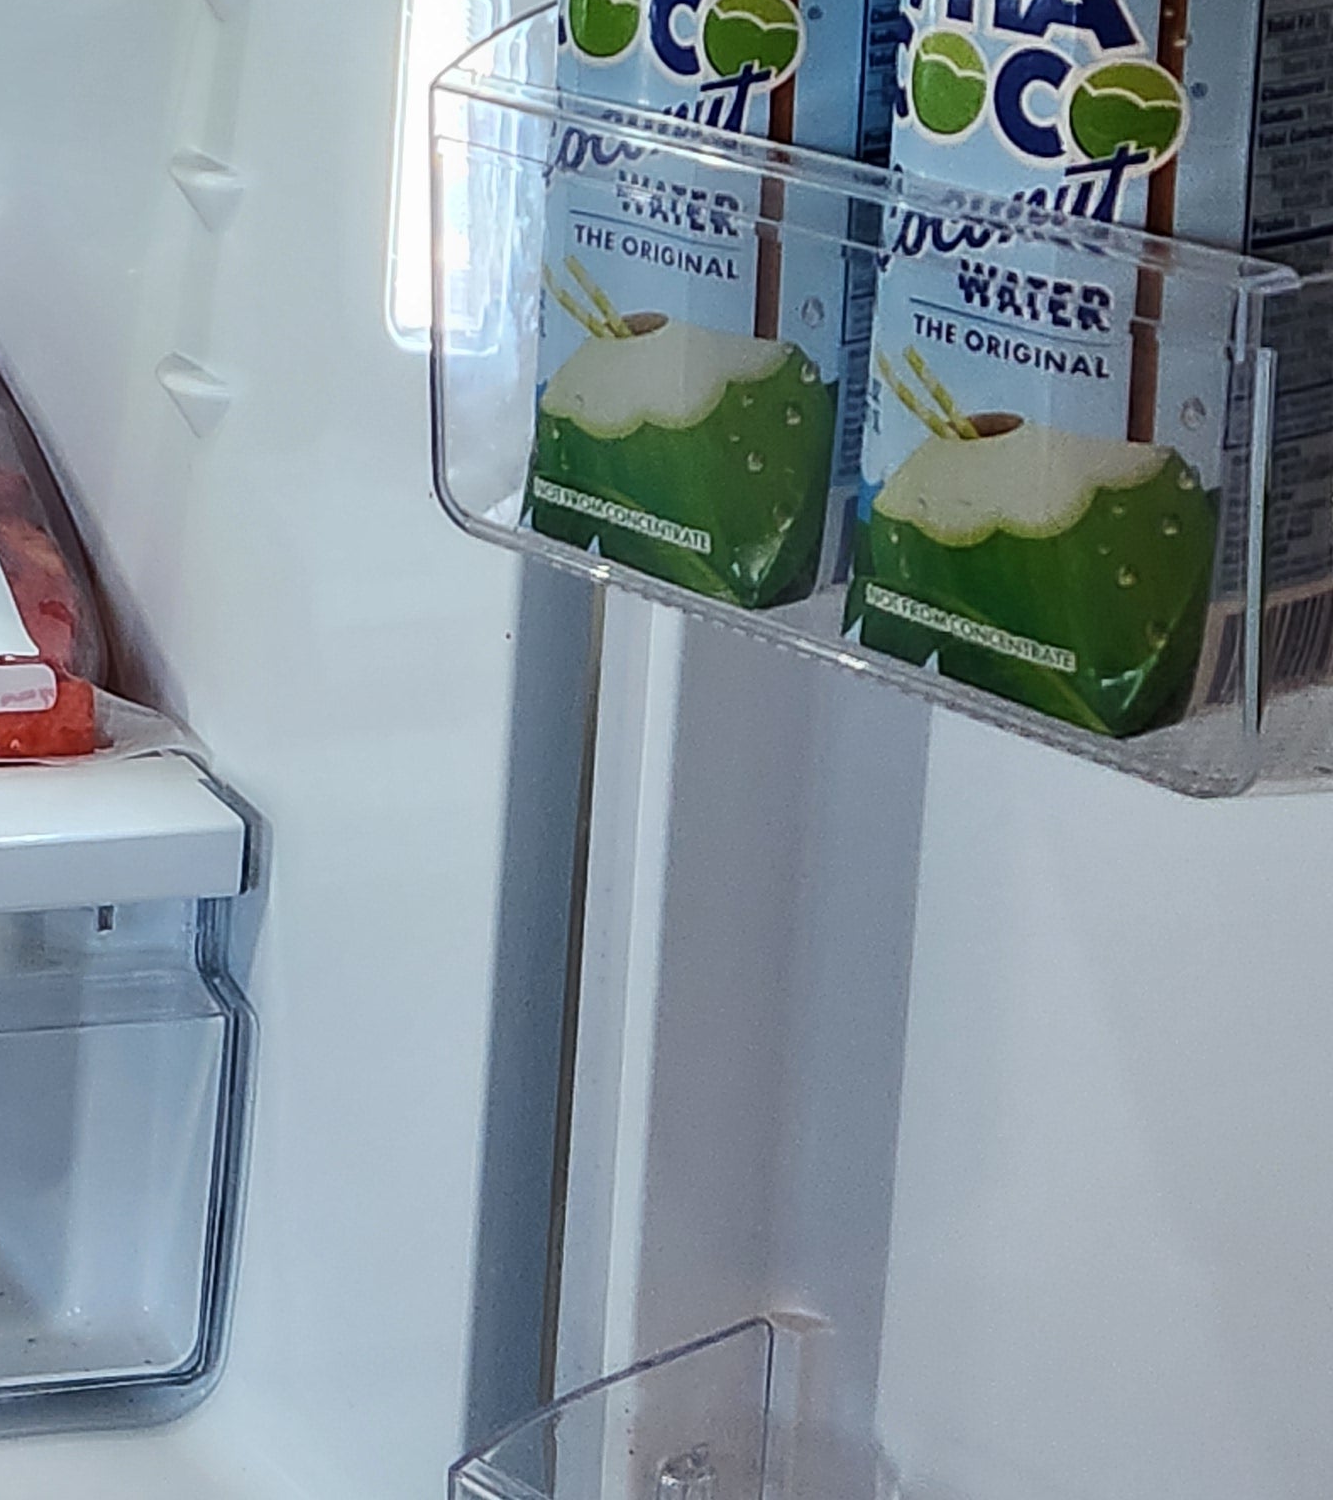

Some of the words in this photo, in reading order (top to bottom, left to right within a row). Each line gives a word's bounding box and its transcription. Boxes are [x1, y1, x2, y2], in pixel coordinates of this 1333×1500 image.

[617, 170, 739, 237] WATER
[575, 224, 616, 250] THE
[621, 236, 740, 279] ORIGINAL
[958, 258, 1111, 332] WATER
[913, 313, 957, 343] THE
[965, 329, 1110, 379] ORIGINAL
[605, 503, 708, 550] CONCENTRATE
[899, 596, 949, 629] FROM
[950, 615, 1072, 668] CONCENTRATE
